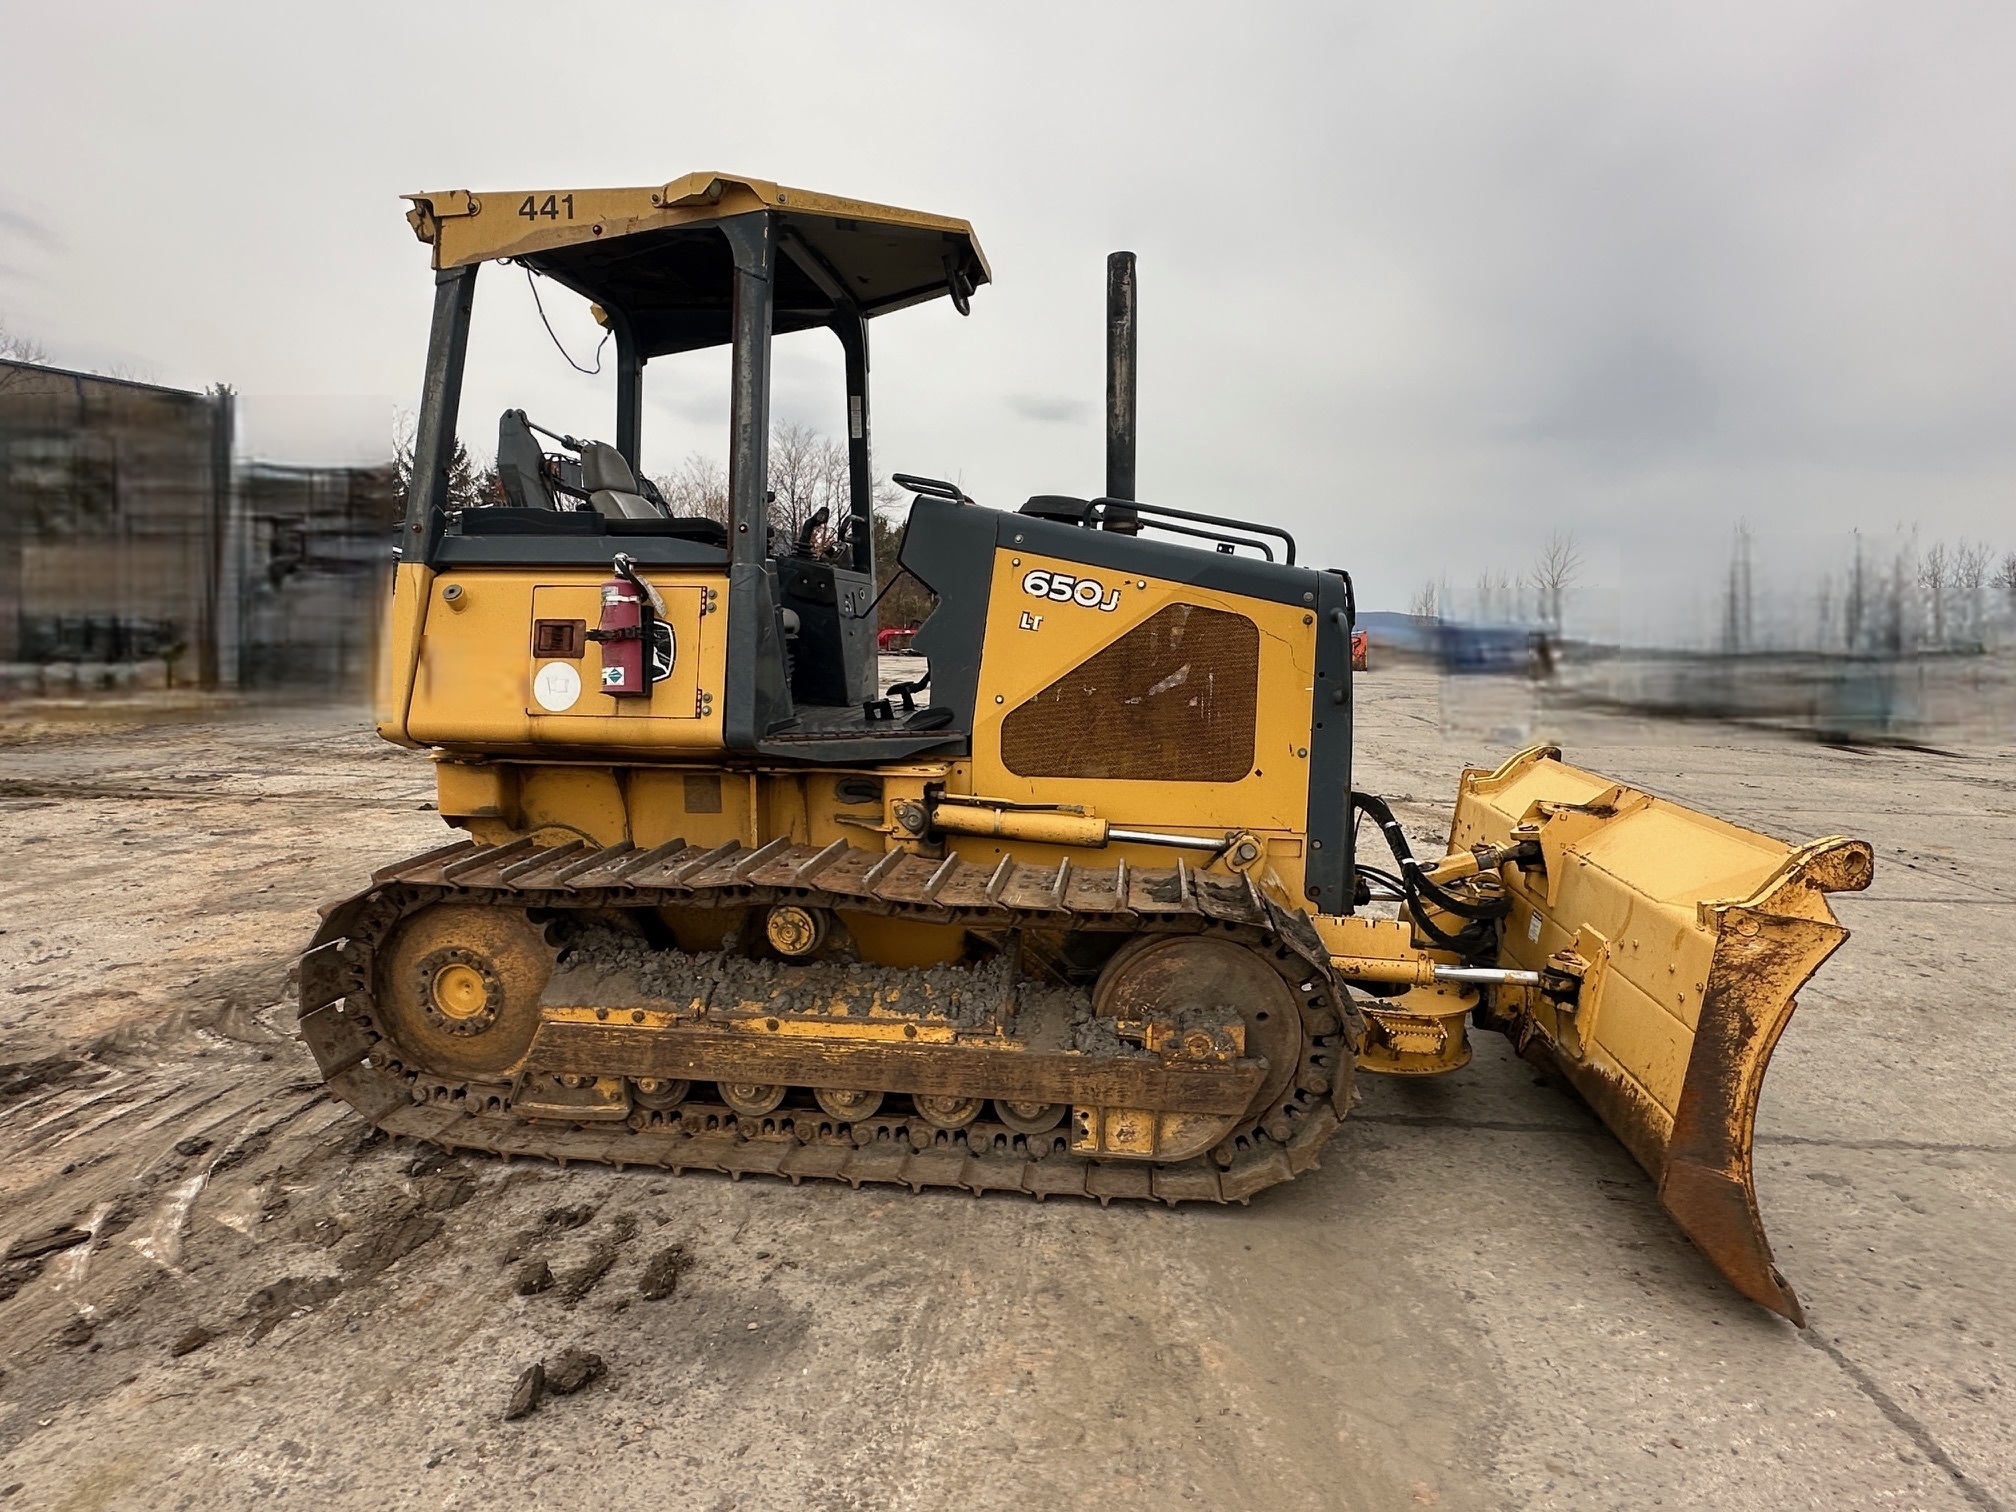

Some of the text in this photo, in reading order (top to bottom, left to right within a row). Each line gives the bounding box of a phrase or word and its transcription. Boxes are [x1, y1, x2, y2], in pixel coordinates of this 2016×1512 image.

[519, 194, 573, 221] 441
[1022, 569, 1121, 612] 650J
[1019, 611, 1044, 631] LT
